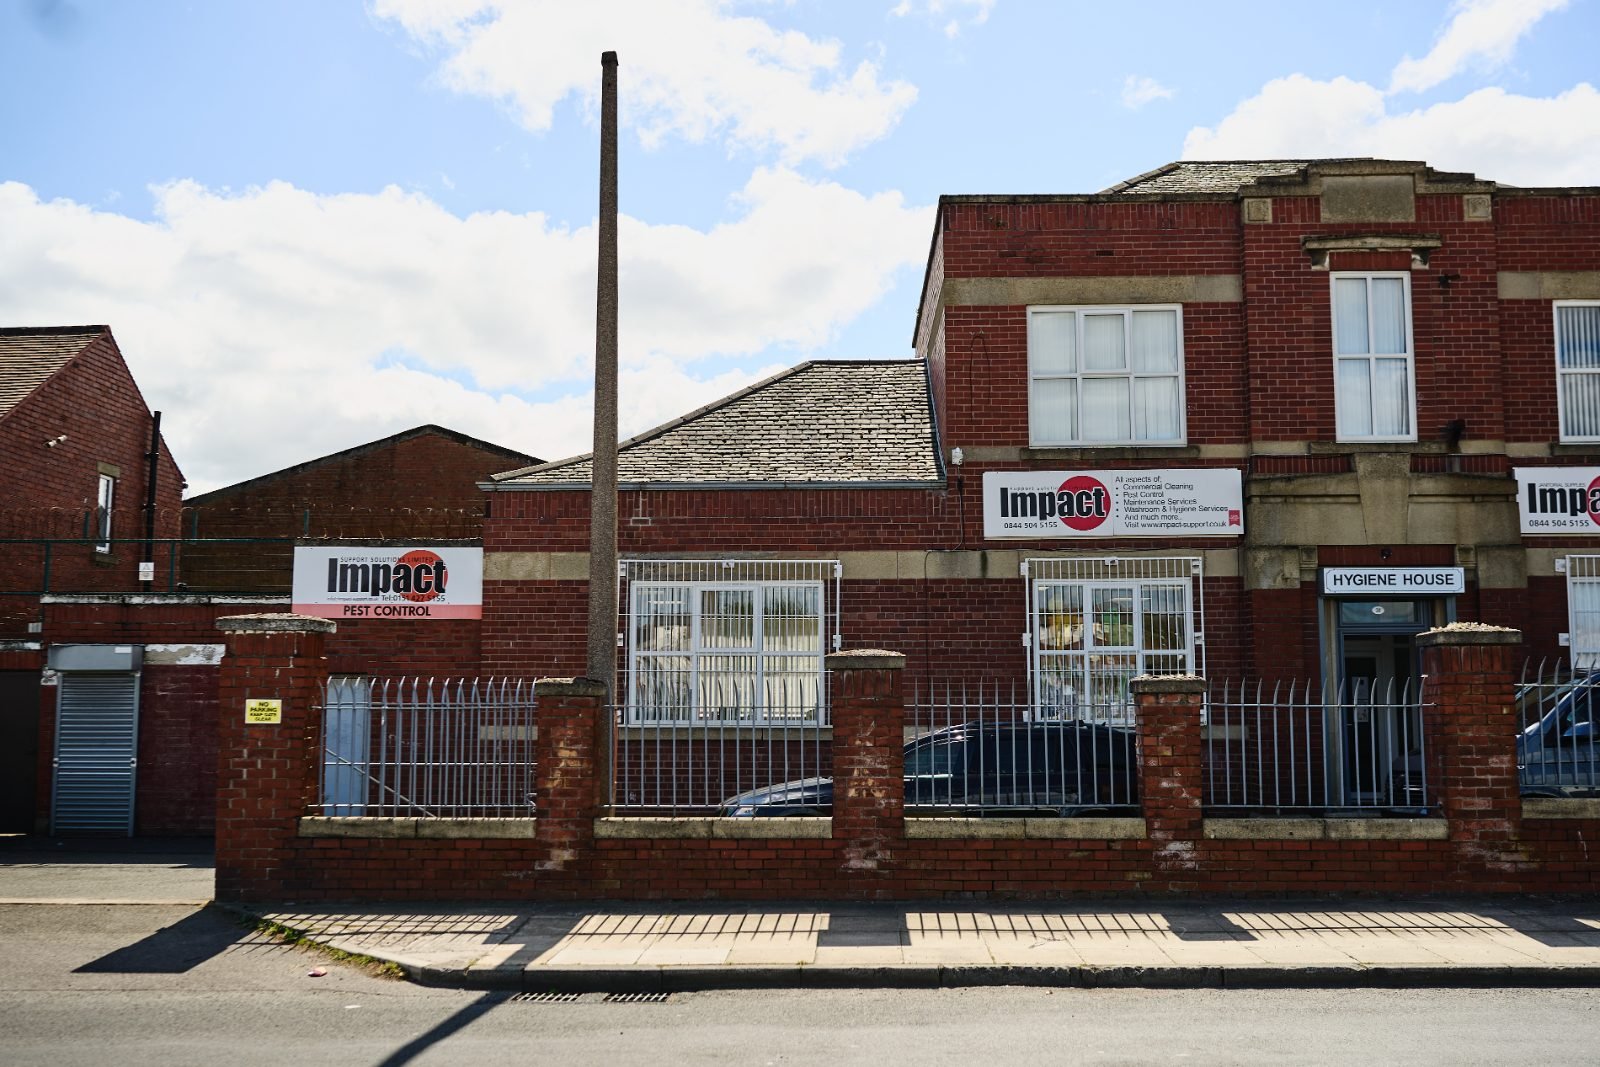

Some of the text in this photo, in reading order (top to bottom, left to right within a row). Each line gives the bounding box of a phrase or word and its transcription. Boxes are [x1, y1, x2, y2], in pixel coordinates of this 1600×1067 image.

[1126, 476, 1151, 484] aspects
[1164, 482, 1194, 491] Cleaning
[1000, 486, 1106, 521] Impact
[1167, 498, 1197, 506] Services
[1169, 505, 1197, 513] Hygiene
[328, 557, 447, 597] Impact
[1333, 574, 1455, 586] HYGIENE HOUSE
[343, 605, 431, 617] PEST CONTROL
